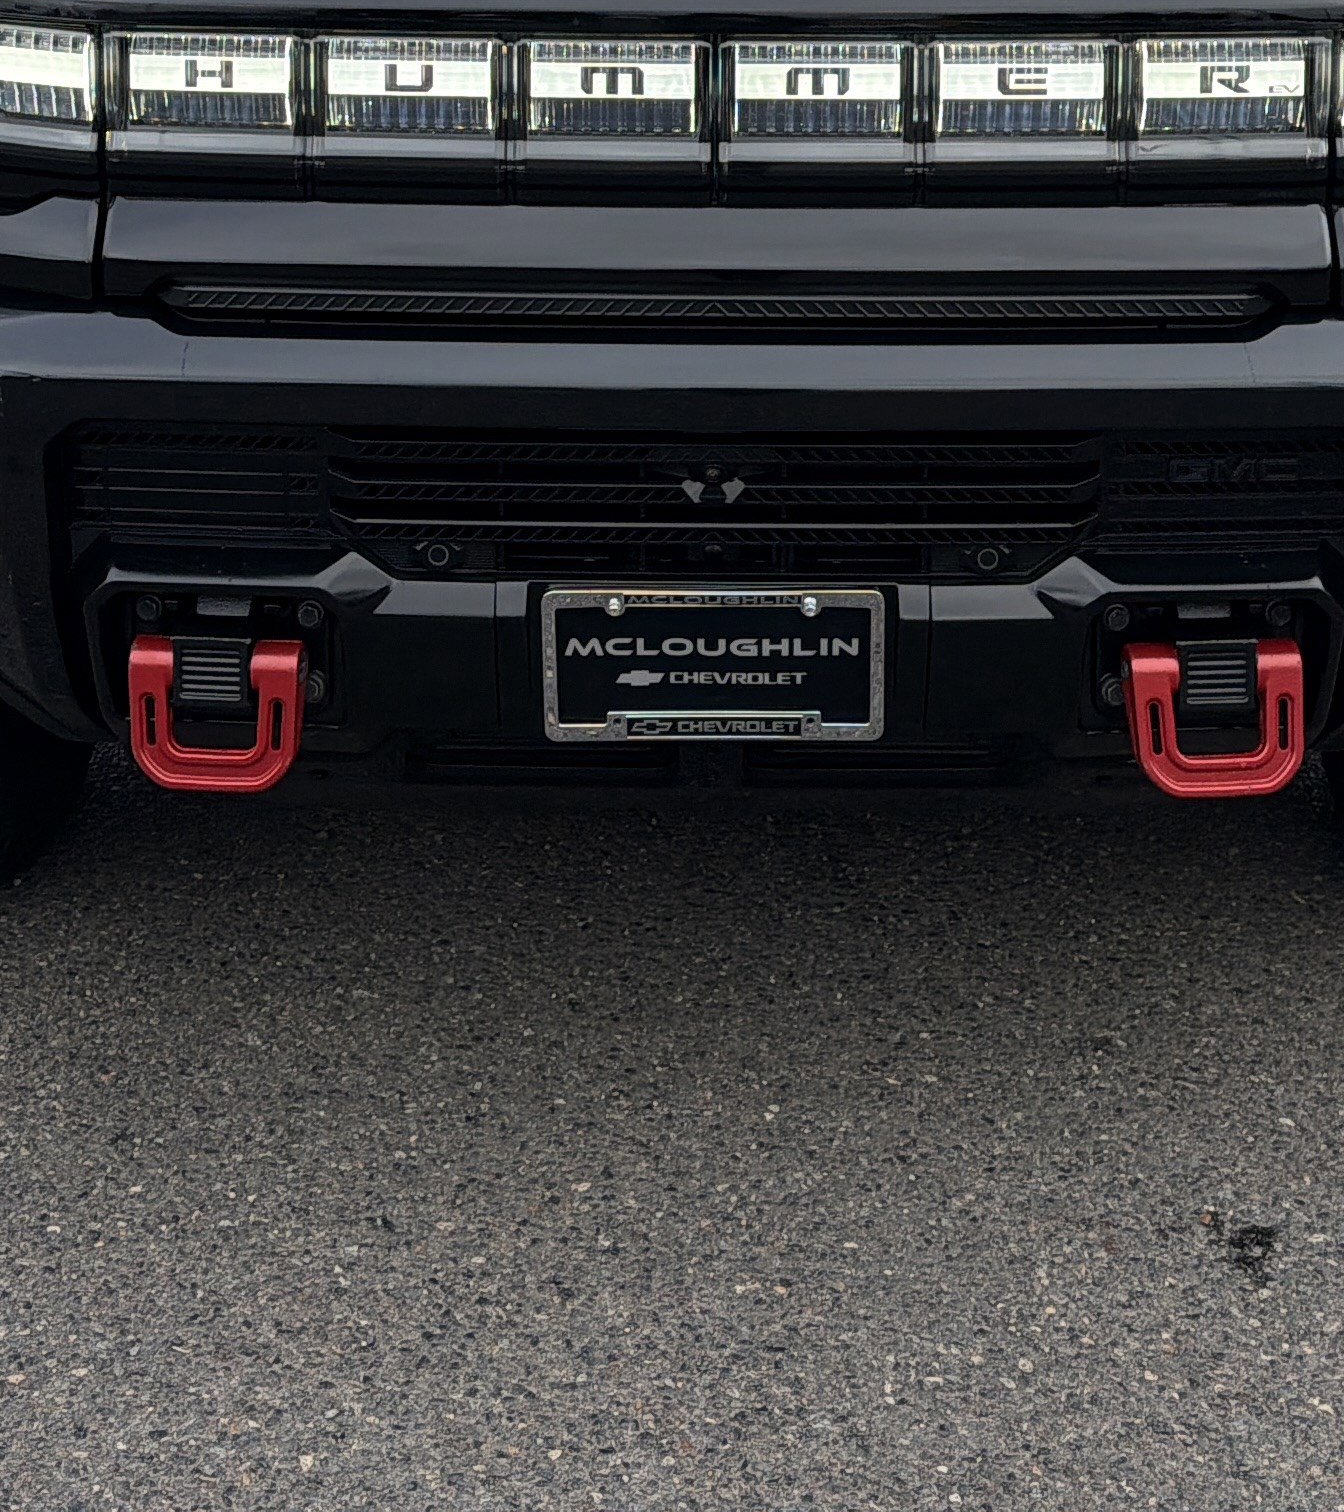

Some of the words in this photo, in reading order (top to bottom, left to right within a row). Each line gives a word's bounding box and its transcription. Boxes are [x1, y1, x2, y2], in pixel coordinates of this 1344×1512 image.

[184, 58, 1251, 97] HUMMER
[1268, 83, 1301, 94] EV
[1168, 457, 1299, 482] GMC
[627, 595, 799, 605] MCLOUGHLIN
[563, 637, 860, 658] MCLOUGHLIN
[669, 671, 808, 686] CHEVROLET
[677, 720, 799, 734] CHEVROLET
